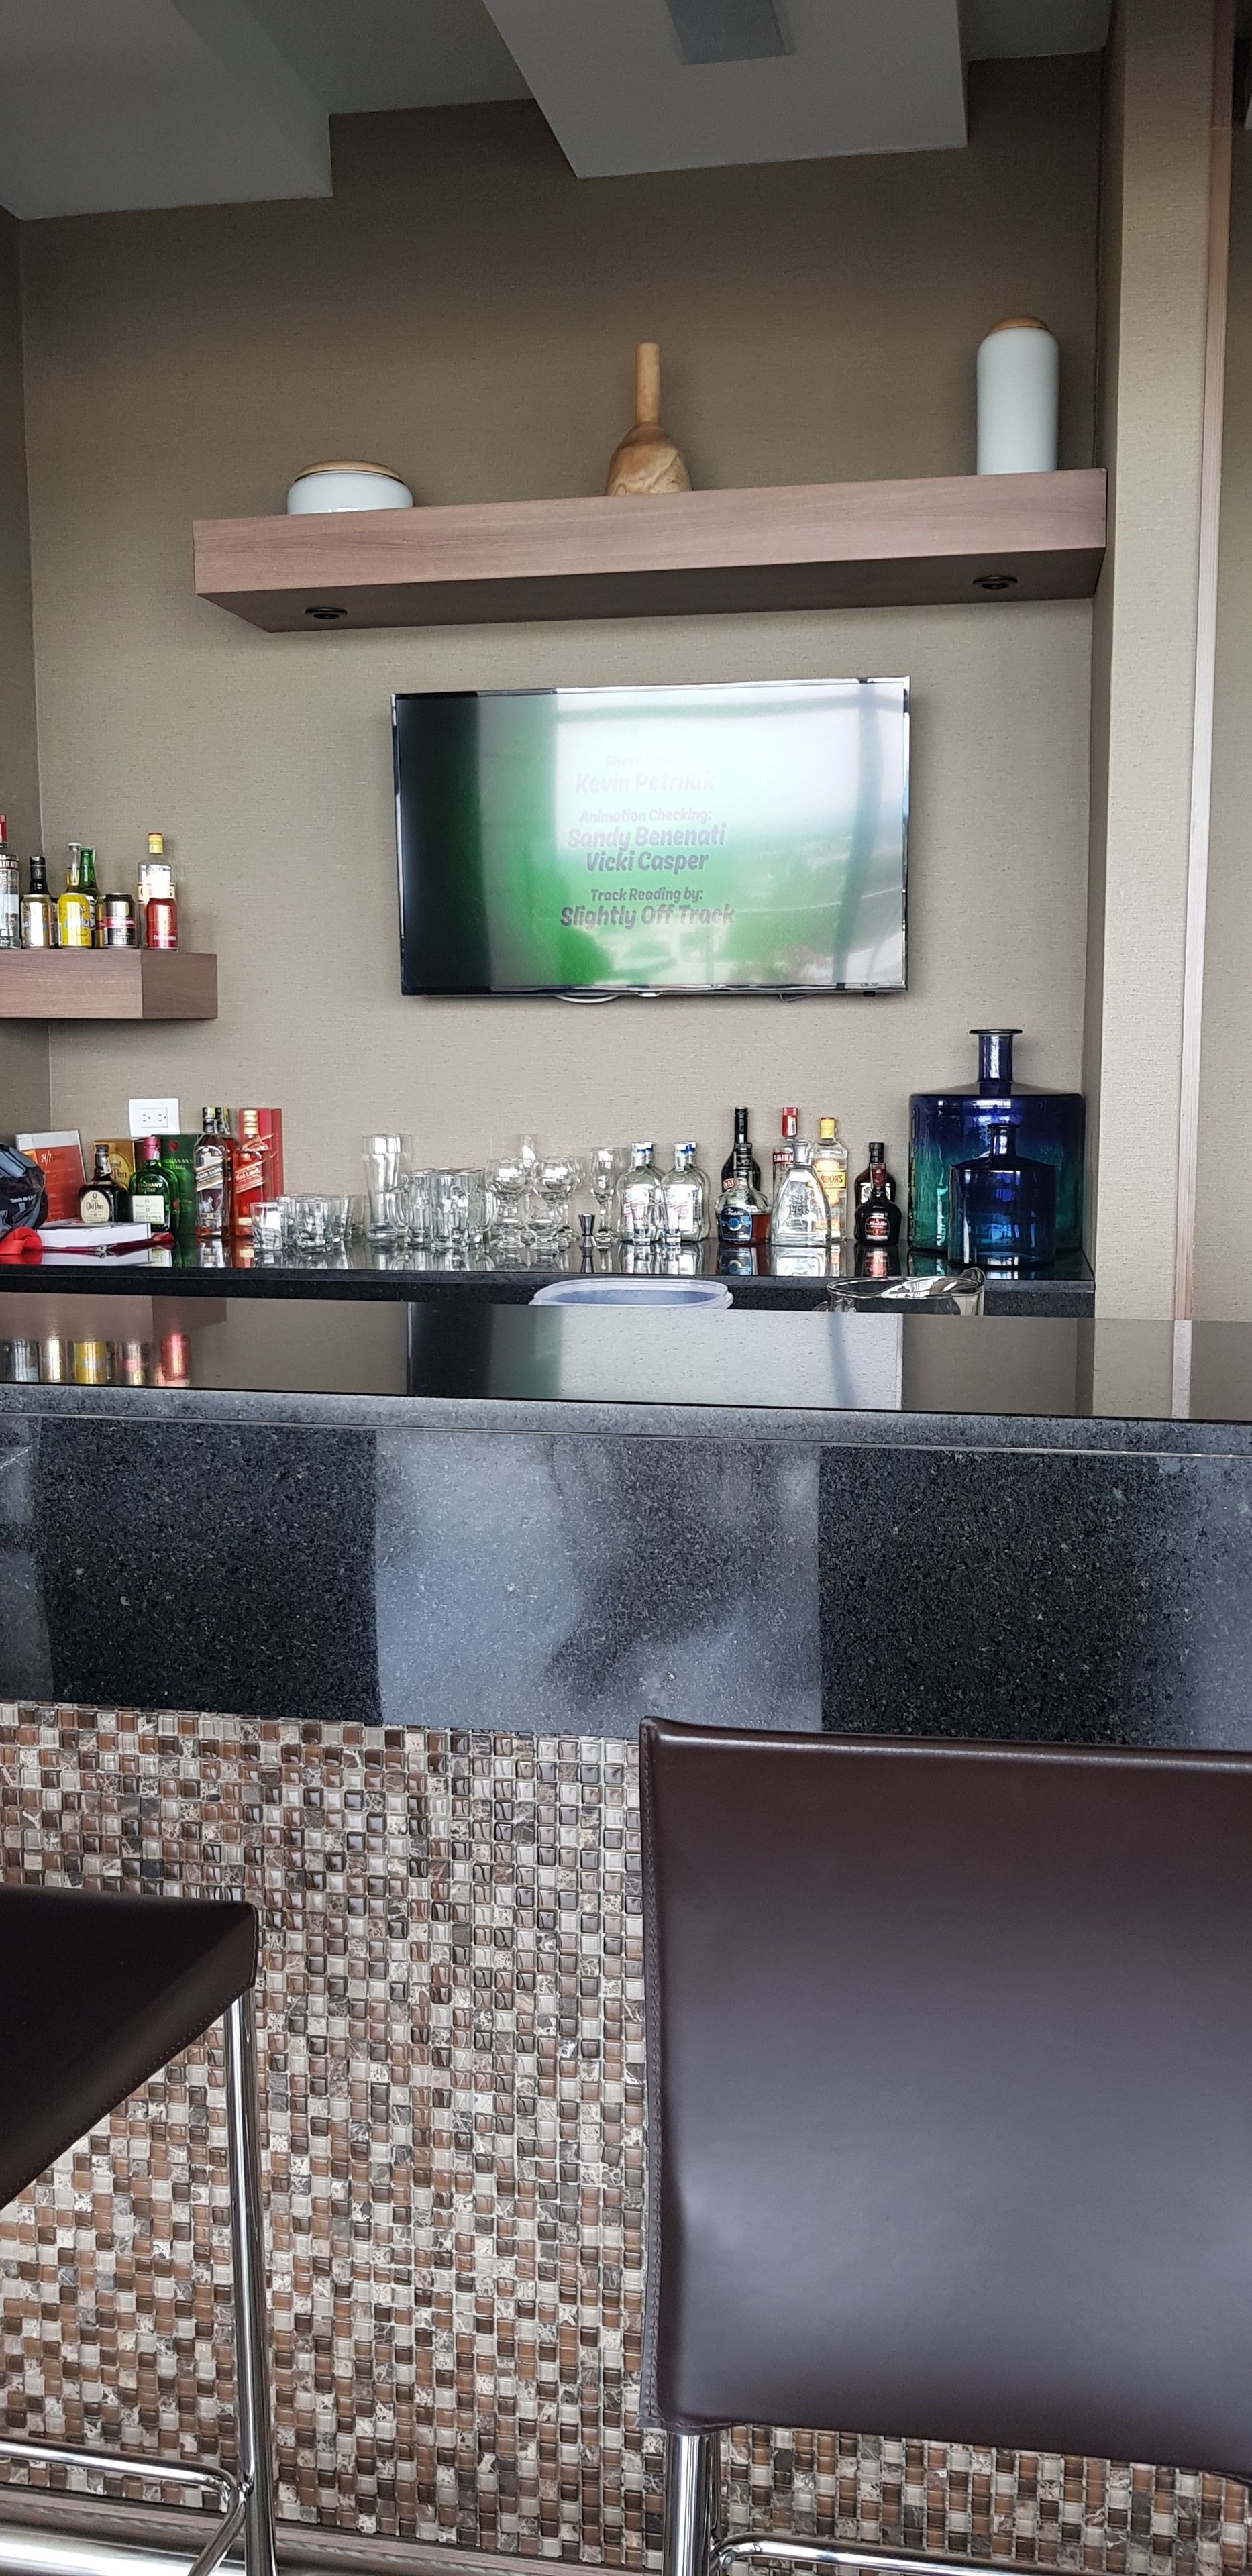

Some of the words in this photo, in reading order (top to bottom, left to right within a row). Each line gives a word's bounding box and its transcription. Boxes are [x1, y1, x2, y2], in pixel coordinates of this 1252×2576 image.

[575, 772, 630, 794] Kevin
[635, 770, 717, 792] Petrilak
[580, 808, 646, 824] Animation
[649, 807, 712, 824] Checking:
[568, 826, 631, 852] Sandy
[635, 823, 727, 847] Benenati
[586, 850, 635, 872] Vicki
[638, 851, 709, 875] Casper
[591, 887, 627, 902] Track
[629, 886, 681, 903] Reading
[684, 886, 703, 902] by:
[560, 905, 637, 930] Slightly
[641, 903, 676, 926] Off
[679, 903, 735, 924] Track
[195, 1171, 209, 1181] BLACK
[209, 1167, 223, 1175] LABEL
[236, 1173, 246, 1181] Red
[86, 1201, 95, 1211] Old
[95, 1202, 104, 1210] Parr
